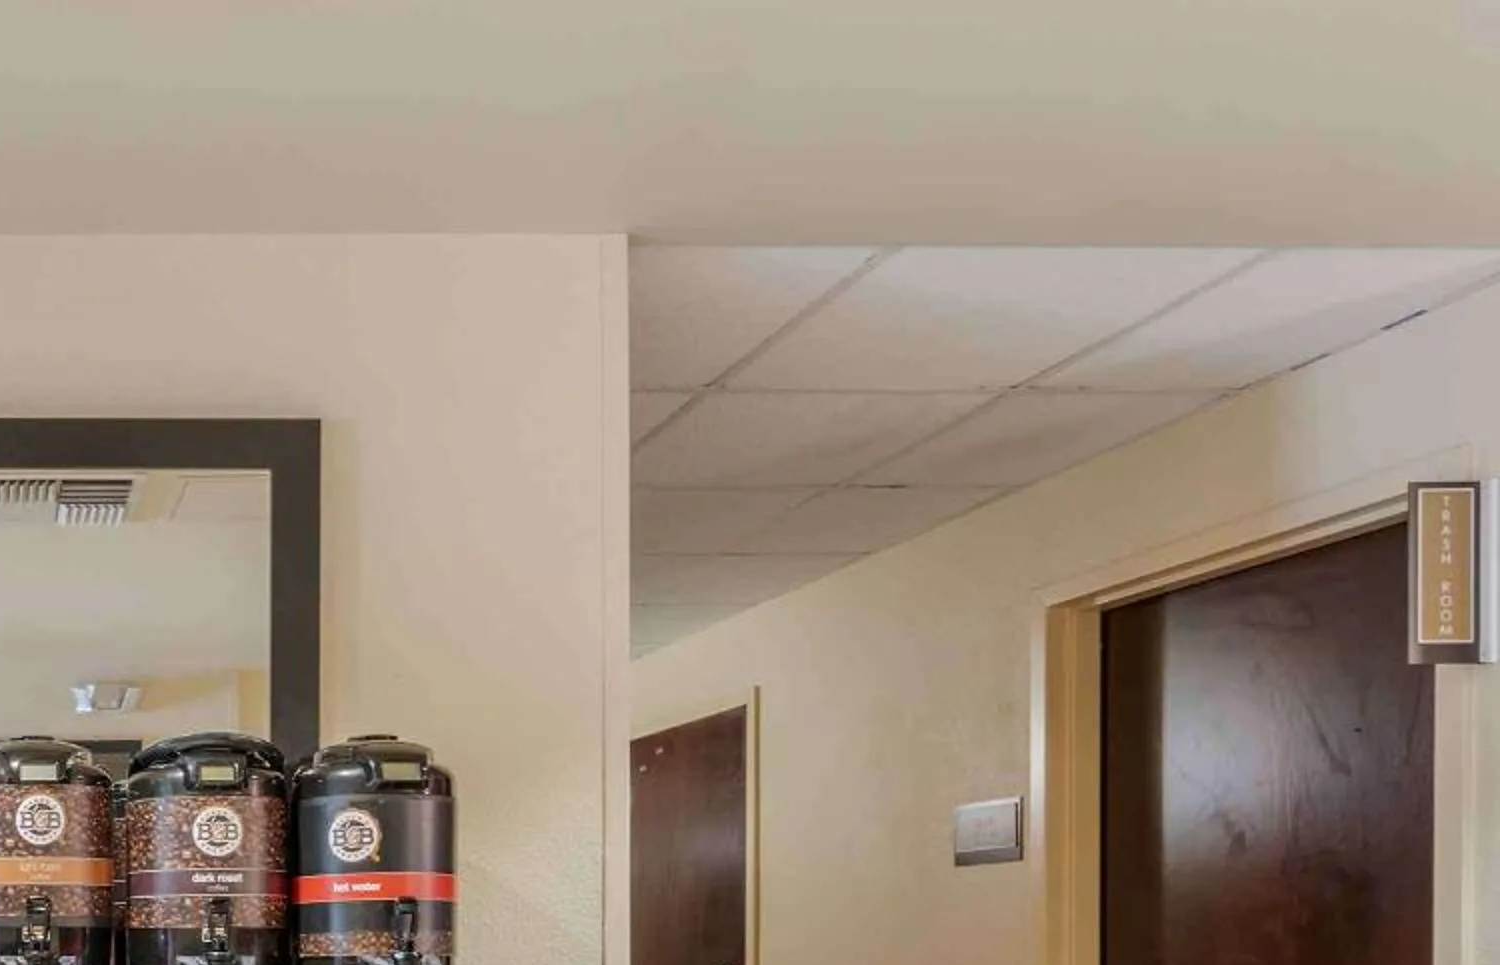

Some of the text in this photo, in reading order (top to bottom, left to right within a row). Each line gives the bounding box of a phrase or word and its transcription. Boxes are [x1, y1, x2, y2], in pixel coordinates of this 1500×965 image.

[1439, 494, 1453, 635] TRASH ROOM
[191, 872, 243, 884] dark roast
